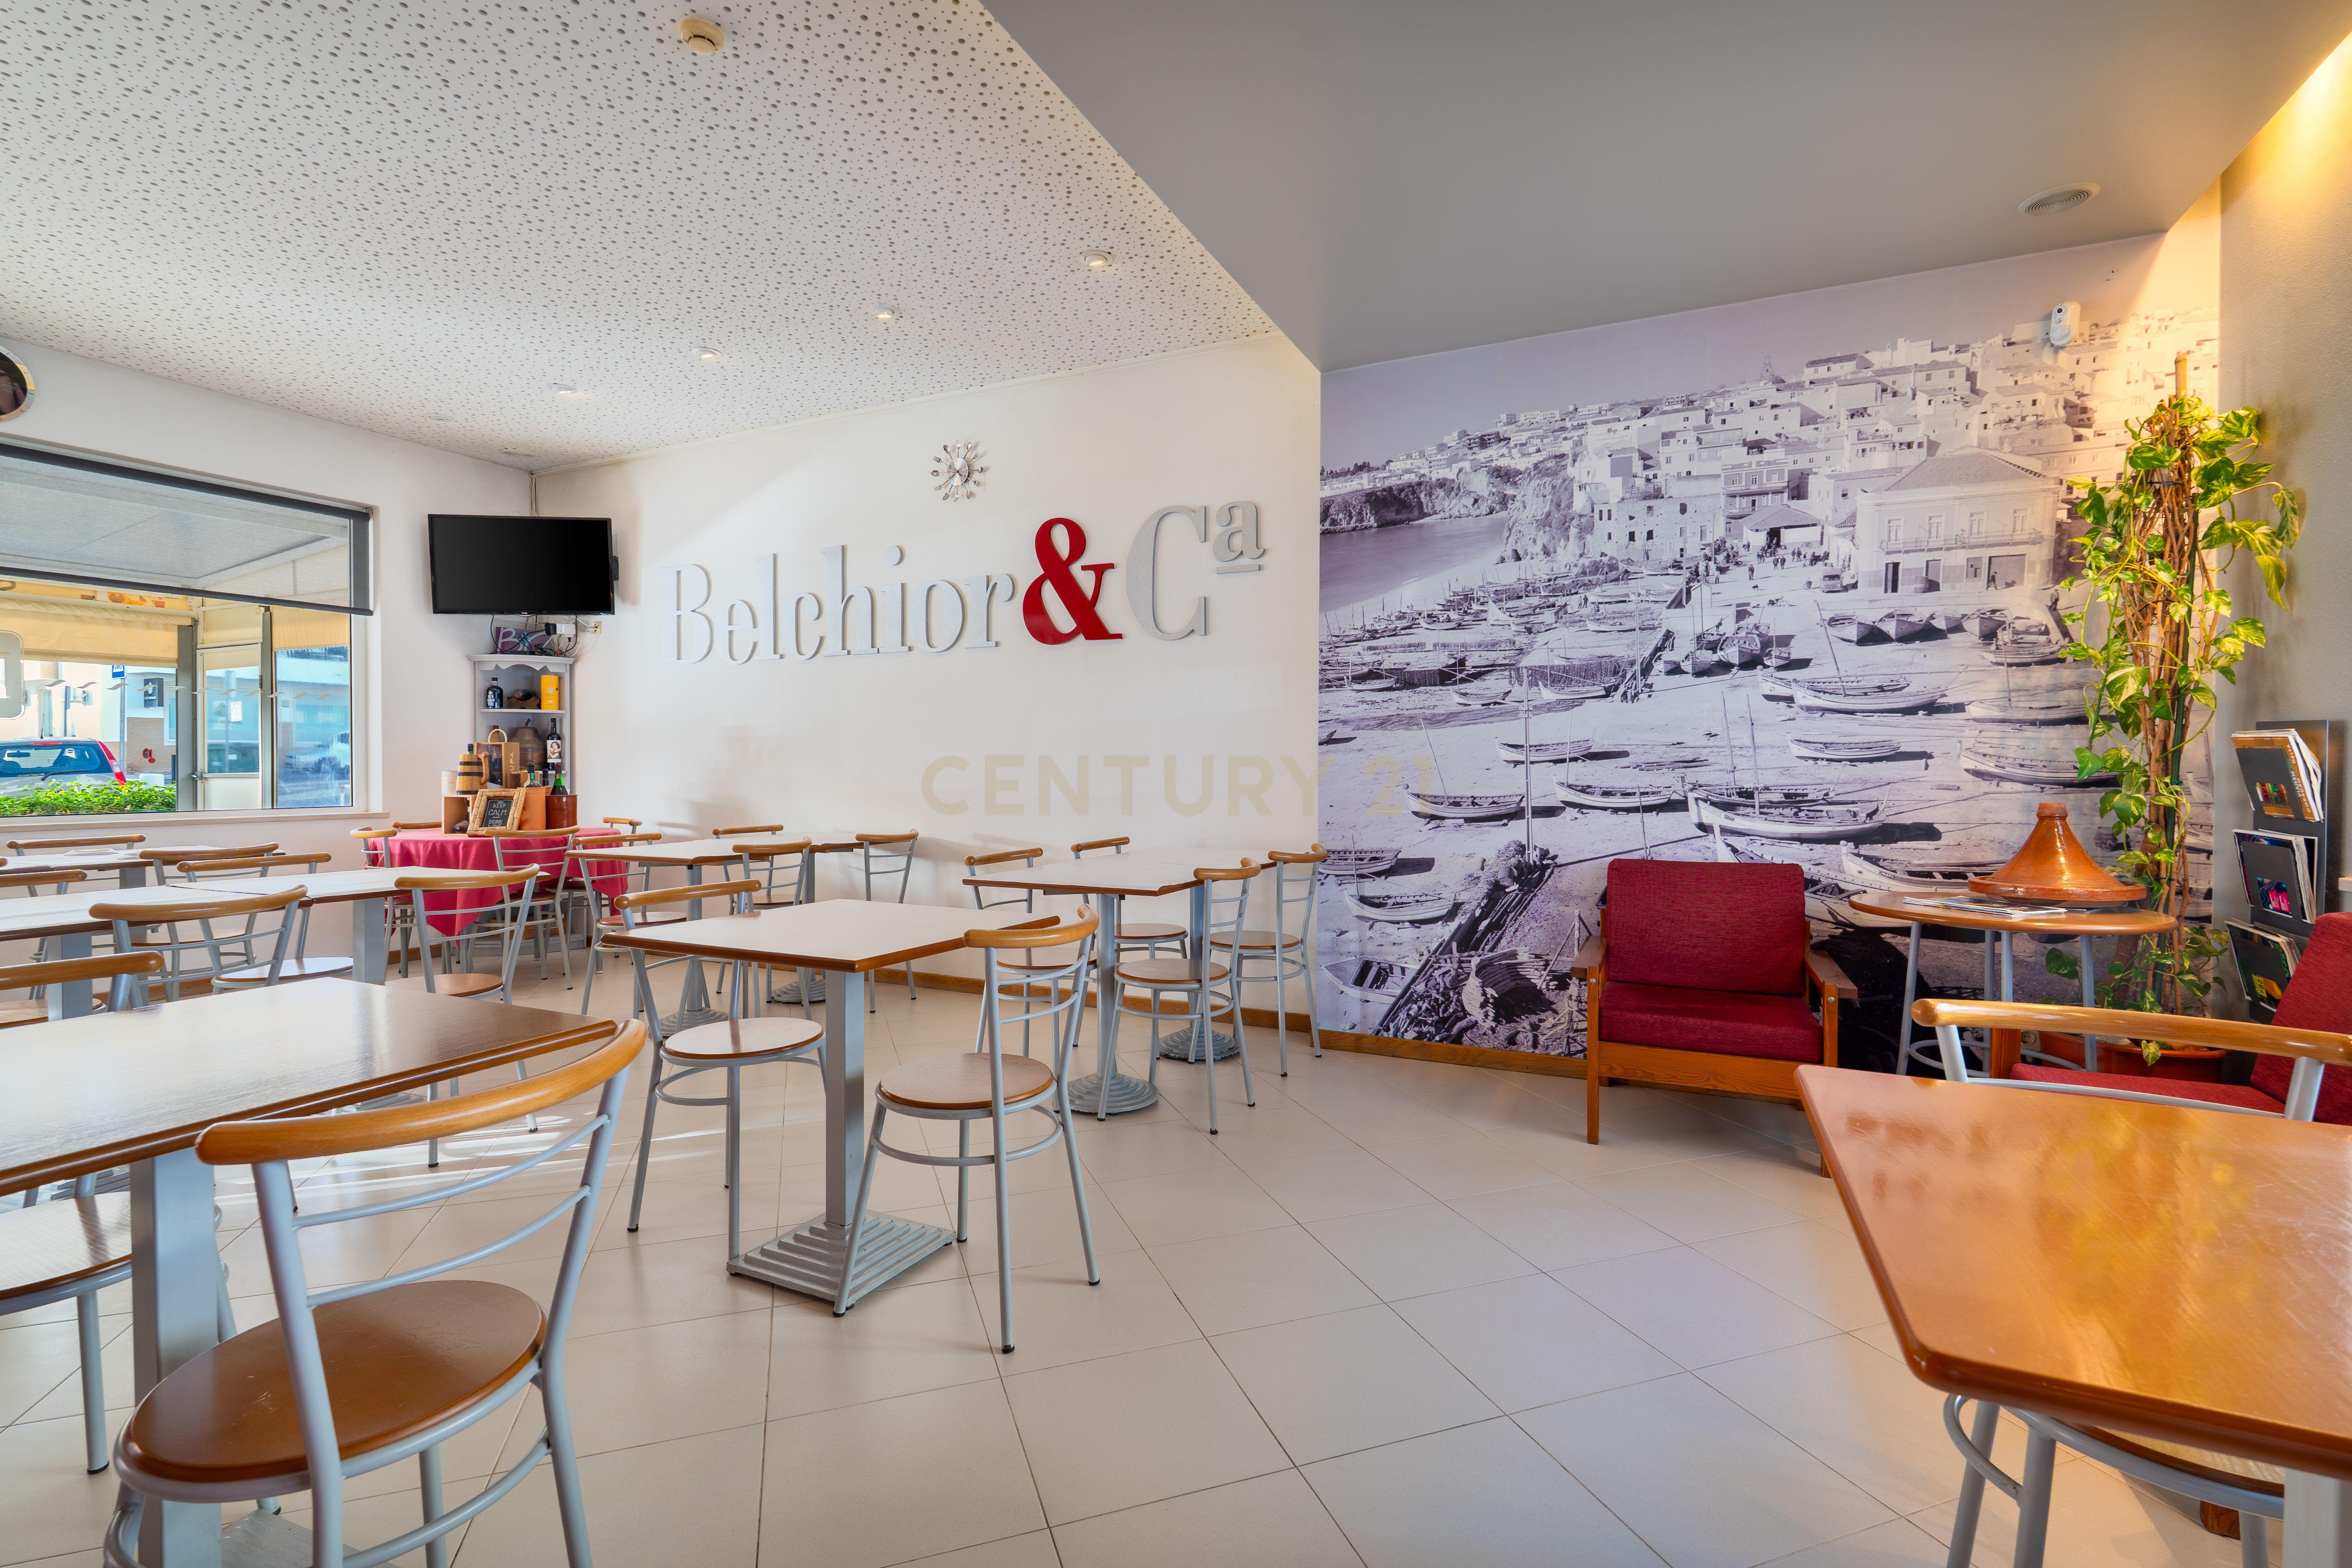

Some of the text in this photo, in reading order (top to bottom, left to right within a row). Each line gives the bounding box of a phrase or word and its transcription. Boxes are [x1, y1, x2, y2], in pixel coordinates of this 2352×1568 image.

[658, 544, 1015, 665] Belchior
[1023, 517, 1123, 645] &
[2287, 744, 2296, 764] DELTA
[2291, 771, 2301, 797] VIAGEM
[2297, 778, 2311, 812] CORAÇÃO
